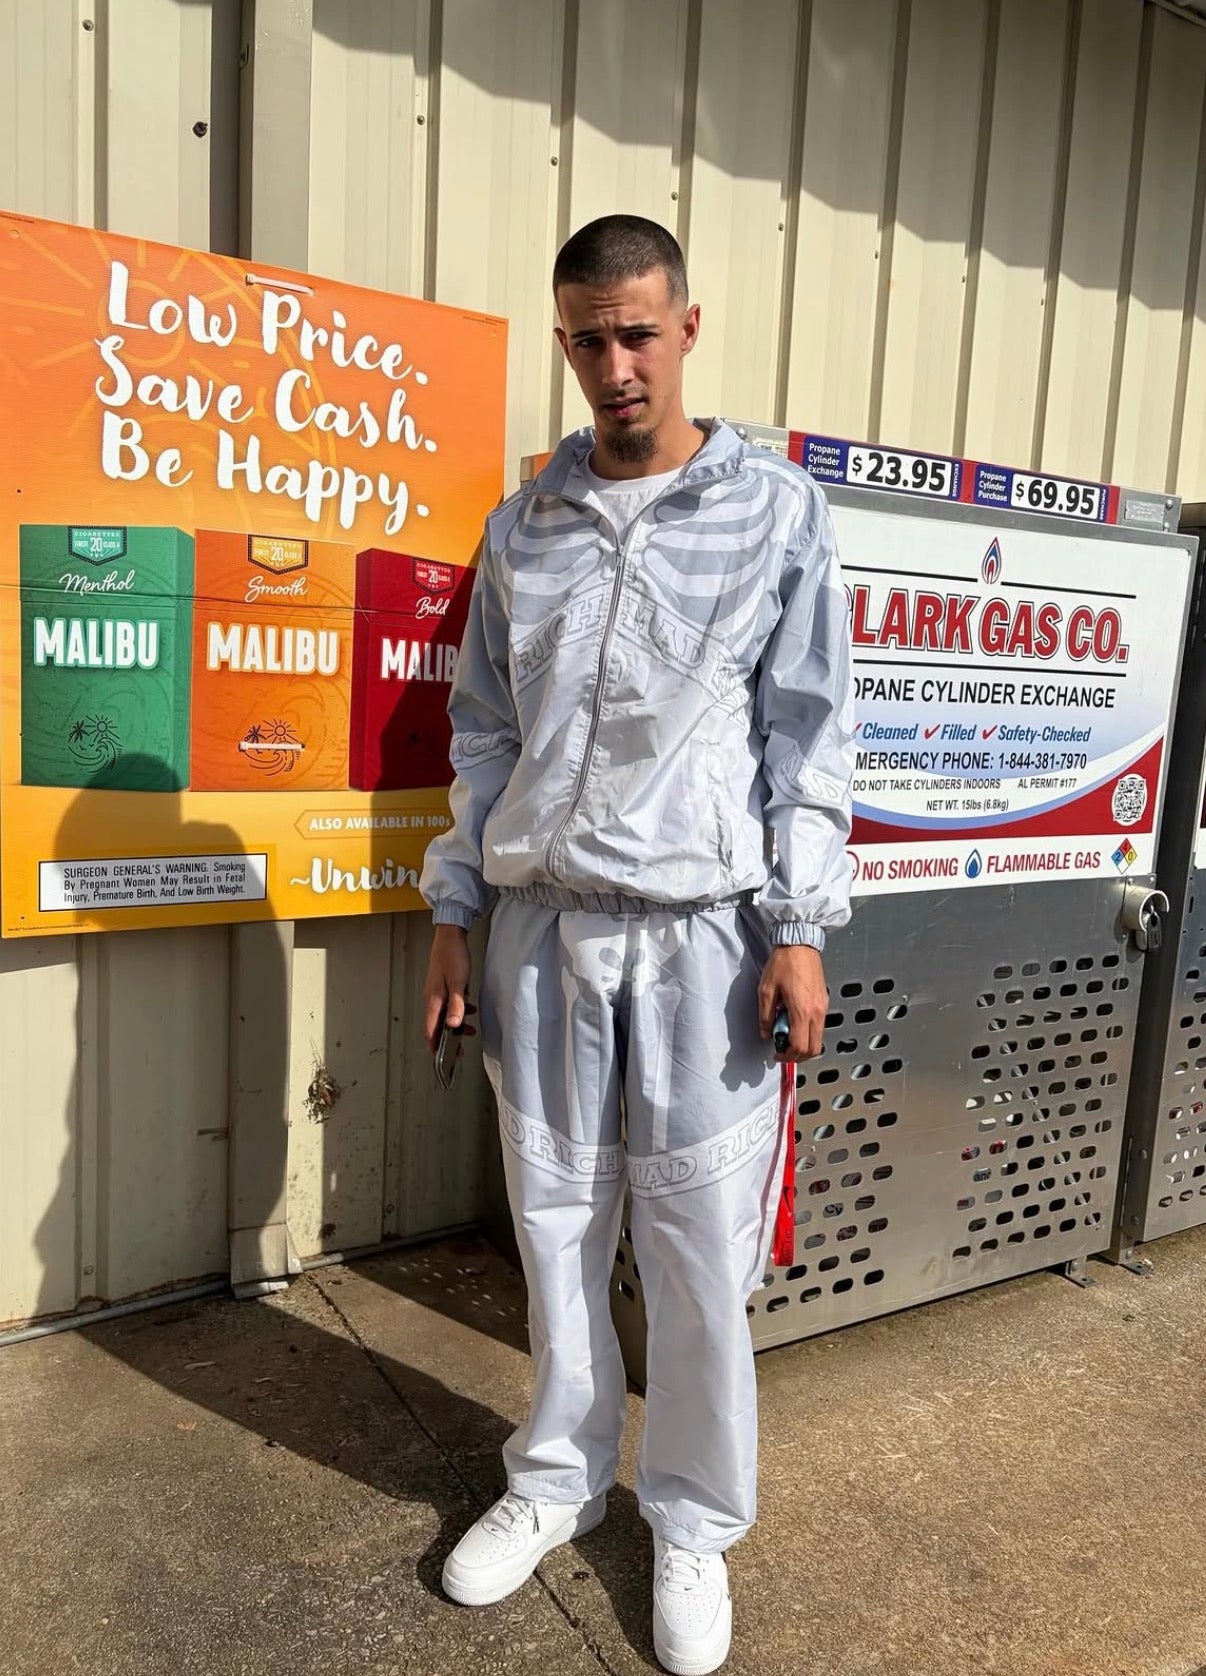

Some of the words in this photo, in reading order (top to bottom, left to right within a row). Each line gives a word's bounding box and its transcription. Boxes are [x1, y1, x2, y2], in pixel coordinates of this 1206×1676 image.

[108, 260, 237, 347] Low
[261, 290, 429, 386] Price.
[94, 336, 254, 423] Save
[275, 368, 438, 453] Cash.
[809, 443, 841, 456] Propane
[808, 454, 840, 466] Cylinder
[101, 410, 193, 487] Be
[216, 429, 430, 536] Happy.
[807, 464, 844, 478] Exchange
[980, 471, 1006, 482] Propane
[978, 490, 1007, 502] Purchase
[979, 481, 1006, 492] Cylinder
[90, 537, 103, 552] 20
[271, 547, 284, 560] 20
[59, 569, 136, 597] Menthol
[428, 569, 438, 583] 20
[244, 576, 308, 602] Smooth
[415, 596, 450, 619] Bold
[843, 584, 981, 654] LARK
[978, 597, 1063, 661] GAS
[1066, 605, 1130, 664] CO.
[34, 618, 158, 667] MALIBU
[207, 622, 339, 673] MALIBU
[516, 596, 604, 683] RICH
[622, 597, 706, 670] MAD
[921, 679, 1015, 705] CYLINDER
[1020, 684, 1116, 708] EXCHANGE
[862, 722, 919, 740] Cleaned
[940, 724, 976, 741] Filled
[997, 725, 1092, 744] Safety-Checked
[941, 752, 994, 770] PHONE:
[998, 752, 1087, 770] 1-844-381-7970
[853, 780, 867, 792] DO
[868, 779, 888, 791] NOT
[890, 779, 912, 791] TAKE
[914, 778, 962, 790] CYLINDERS
[964, 778, 1001, 790] INDOORS
[1017, 778, 1028, 789] AL
[1030, 778, 1058, 789] PERMIT
[1060, 777, 1077, 789] #177
[926, 800, 943, 811] NET
[945, 799, 959, 811] WT.
[961, 799, 982, 810] 15lbs
[983, 799, 1009, 812] (6.8kg)
[309, 818, 343, 831] ALSO
[345, 816, 408, 830] AVAILABLE
[411, 815, 424, 828] IN
[64, 867, 108, 878] SURGEON
[113, 864, 161, 876] GENERAL'S
[213, 862, 246, 874] Smoking
[862, 861, 884, 882] NO
[888, 857, 959, 879] SMOKING
[986, 853, 1071, 874] FLAMMABLE
[1074, 851, 1101, 869] GAS
[64, 880, 76, 892] By
[80, 878, 120, 892] Pregnant
[123, 877, 156, 888] Women
[160, 876, 179, 888] May
[183, 874, 210, 885] Result
[214, 874, 222, 884] in
[225, 873, 246, 883] Fetal
[64, 891, 91, 905] Injury,
[93, 889, 134, 901] Premature
[160, 888, 176, 898] And
[177, 886, 194, 897] Low
[196, 885, 215, 896] Birth
[530, 1125, 621, 1175] RICH
